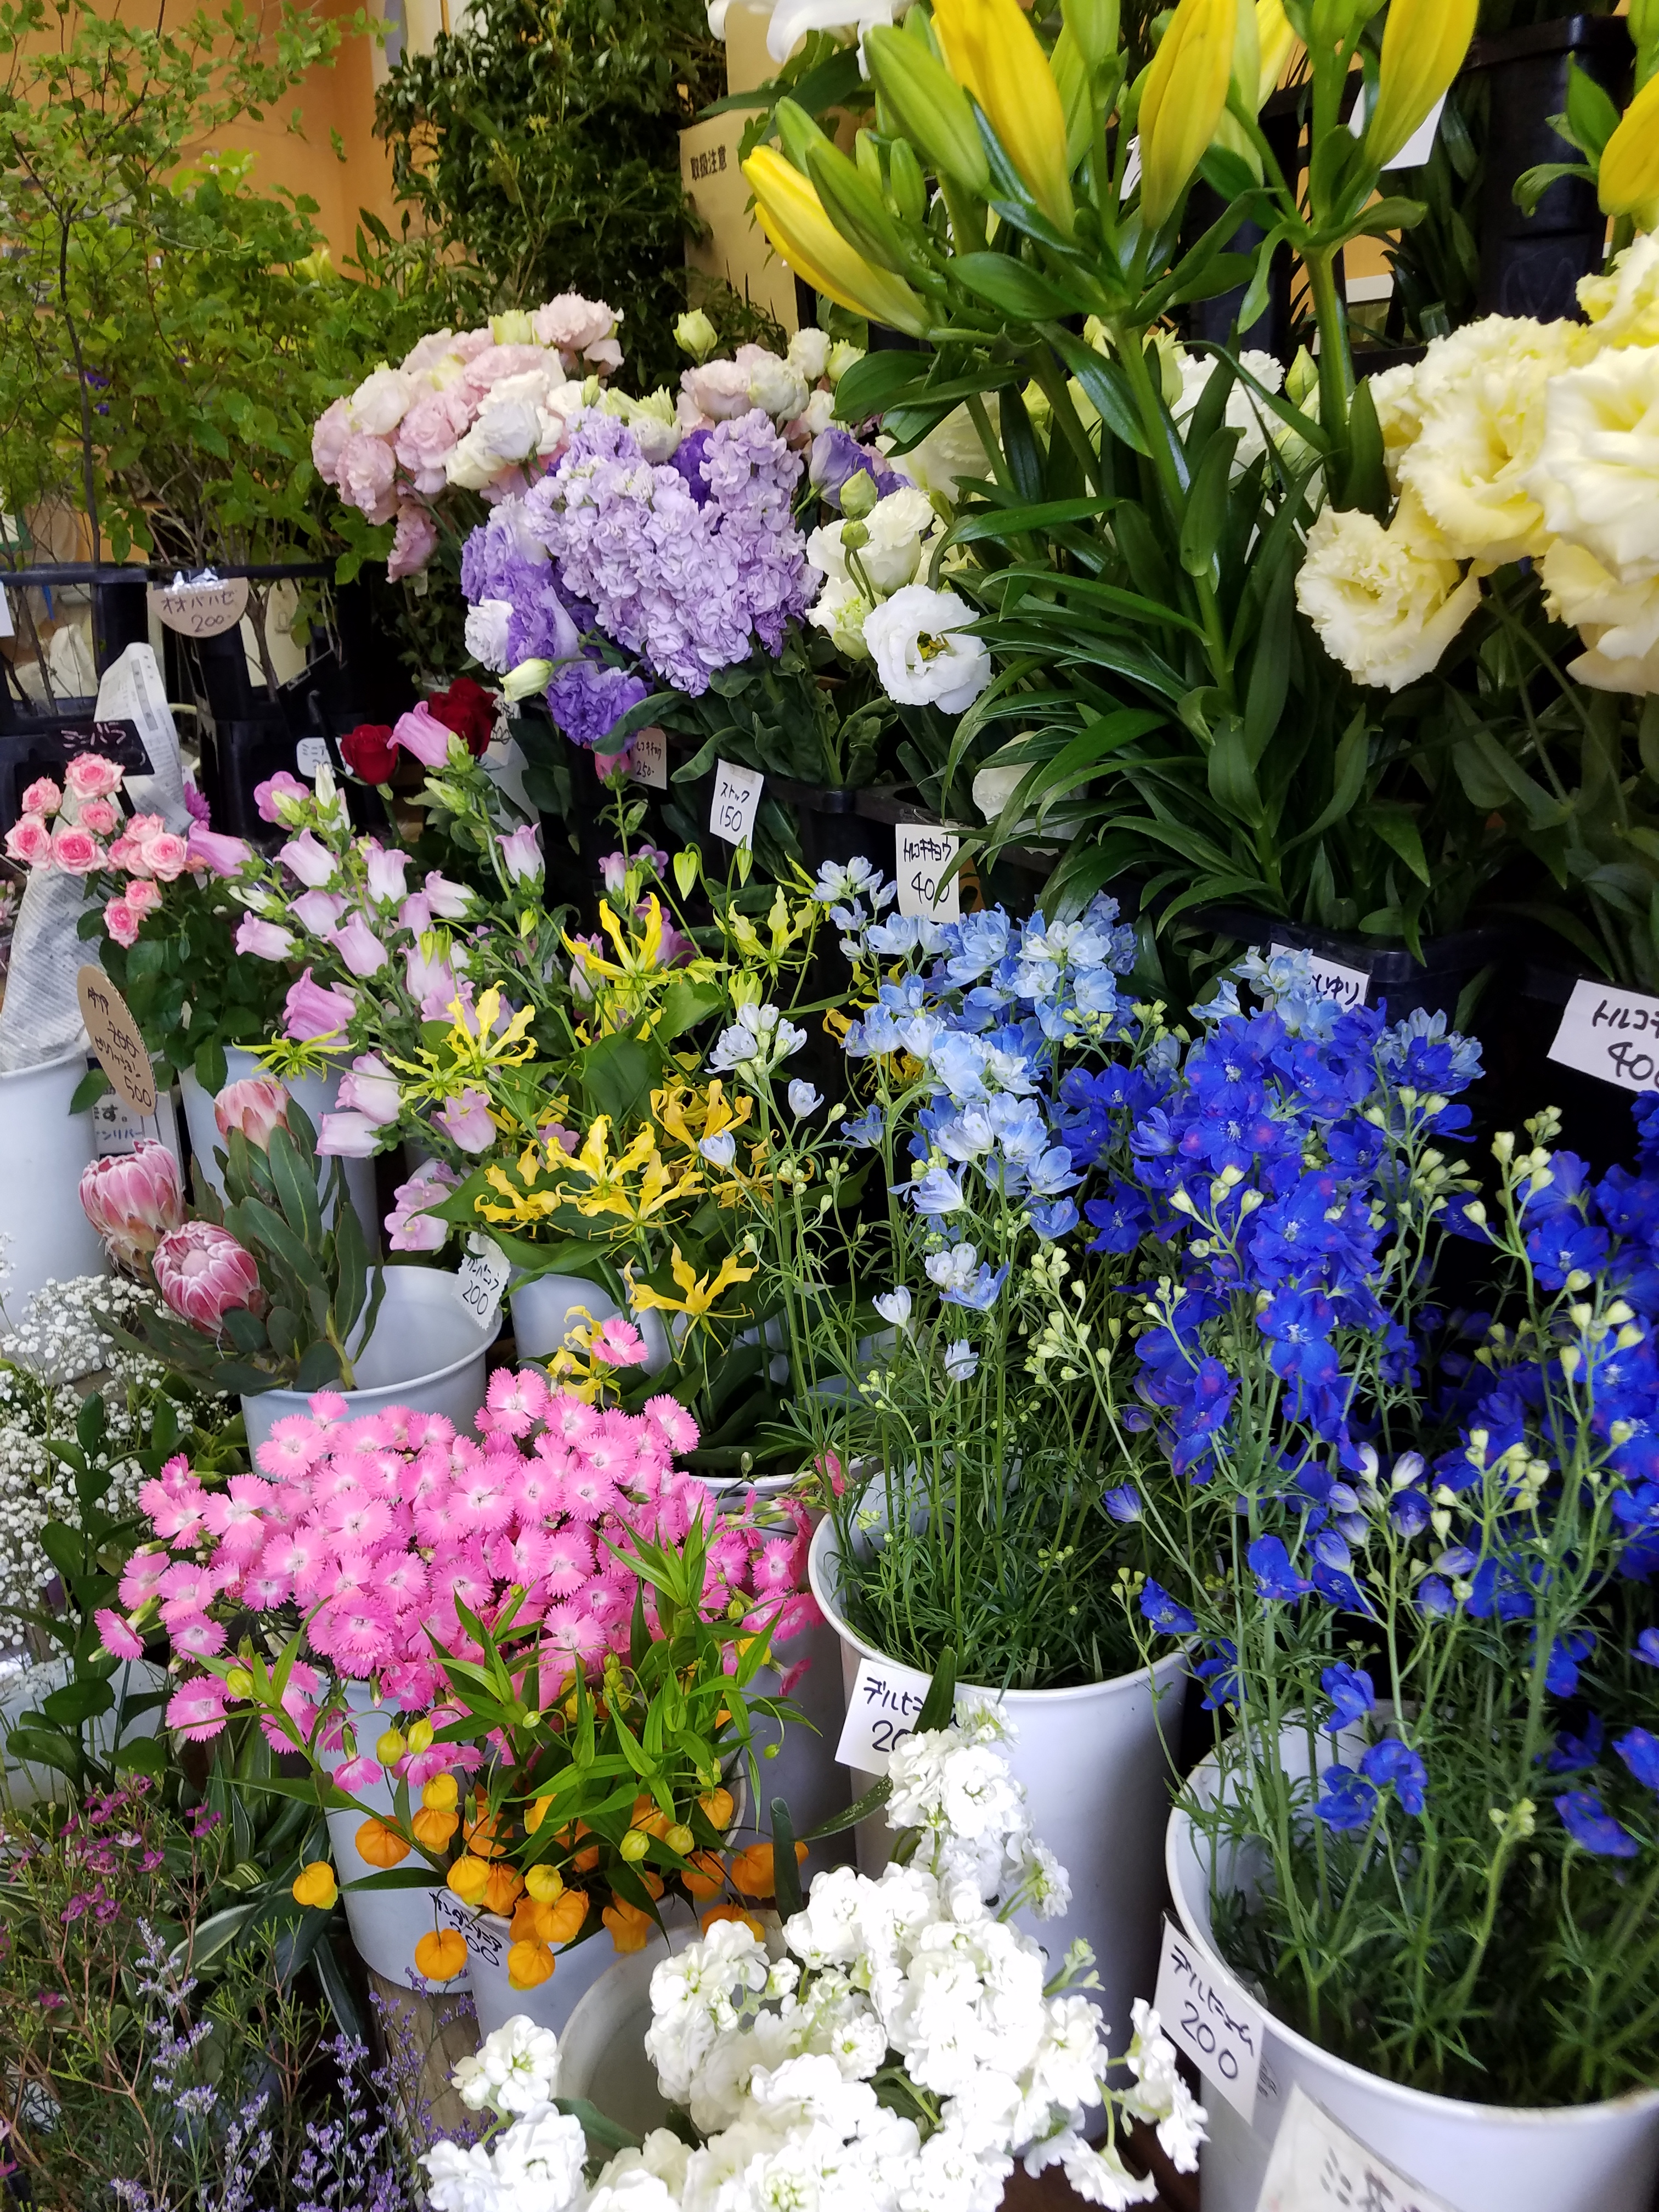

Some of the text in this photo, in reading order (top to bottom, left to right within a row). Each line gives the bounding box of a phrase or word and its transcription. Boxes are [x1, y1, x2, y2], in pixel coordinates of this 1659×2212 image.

[690, 145, 727, 181] 取扱注意
[720, 781, 750, 804] ストック
[719, 804, 743, 832] 150
[123, 1075, 152, 1108] 500
[462, 1279, 489, 1315] 200
[1180, 1999, 1239, 2080] 200
